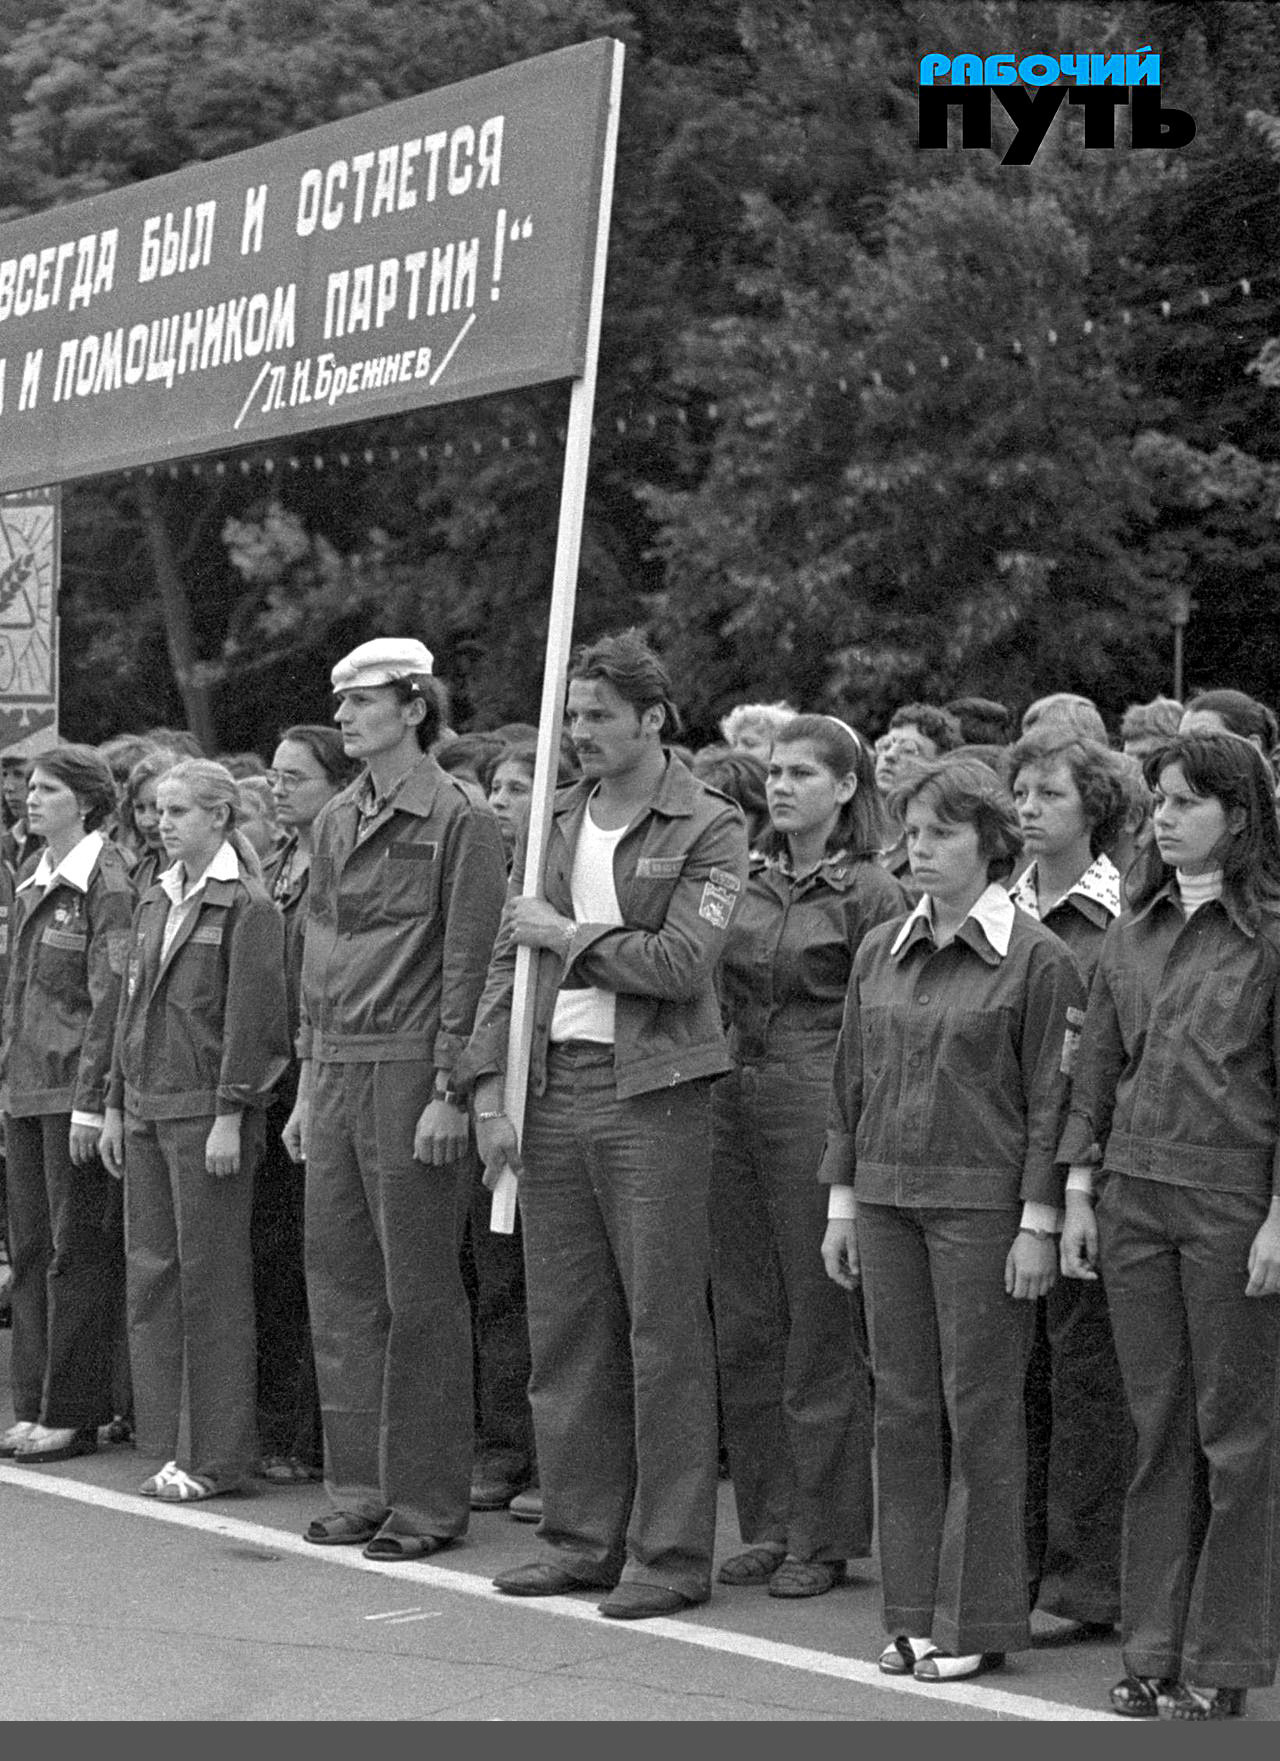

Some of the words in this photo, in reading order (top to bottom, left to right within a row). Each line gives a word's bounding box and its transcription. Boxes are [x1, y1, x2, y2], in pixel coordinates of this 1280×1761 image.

[137, 199, 217, 283] БЫЛ
[240, 184, 268, 256] И
[296, 115, 505, 237] ОСТАЕТСЯ
[18, 348, 44, 412] И
[52, 284, 297, 402] ПОМОЩНИКОМ
